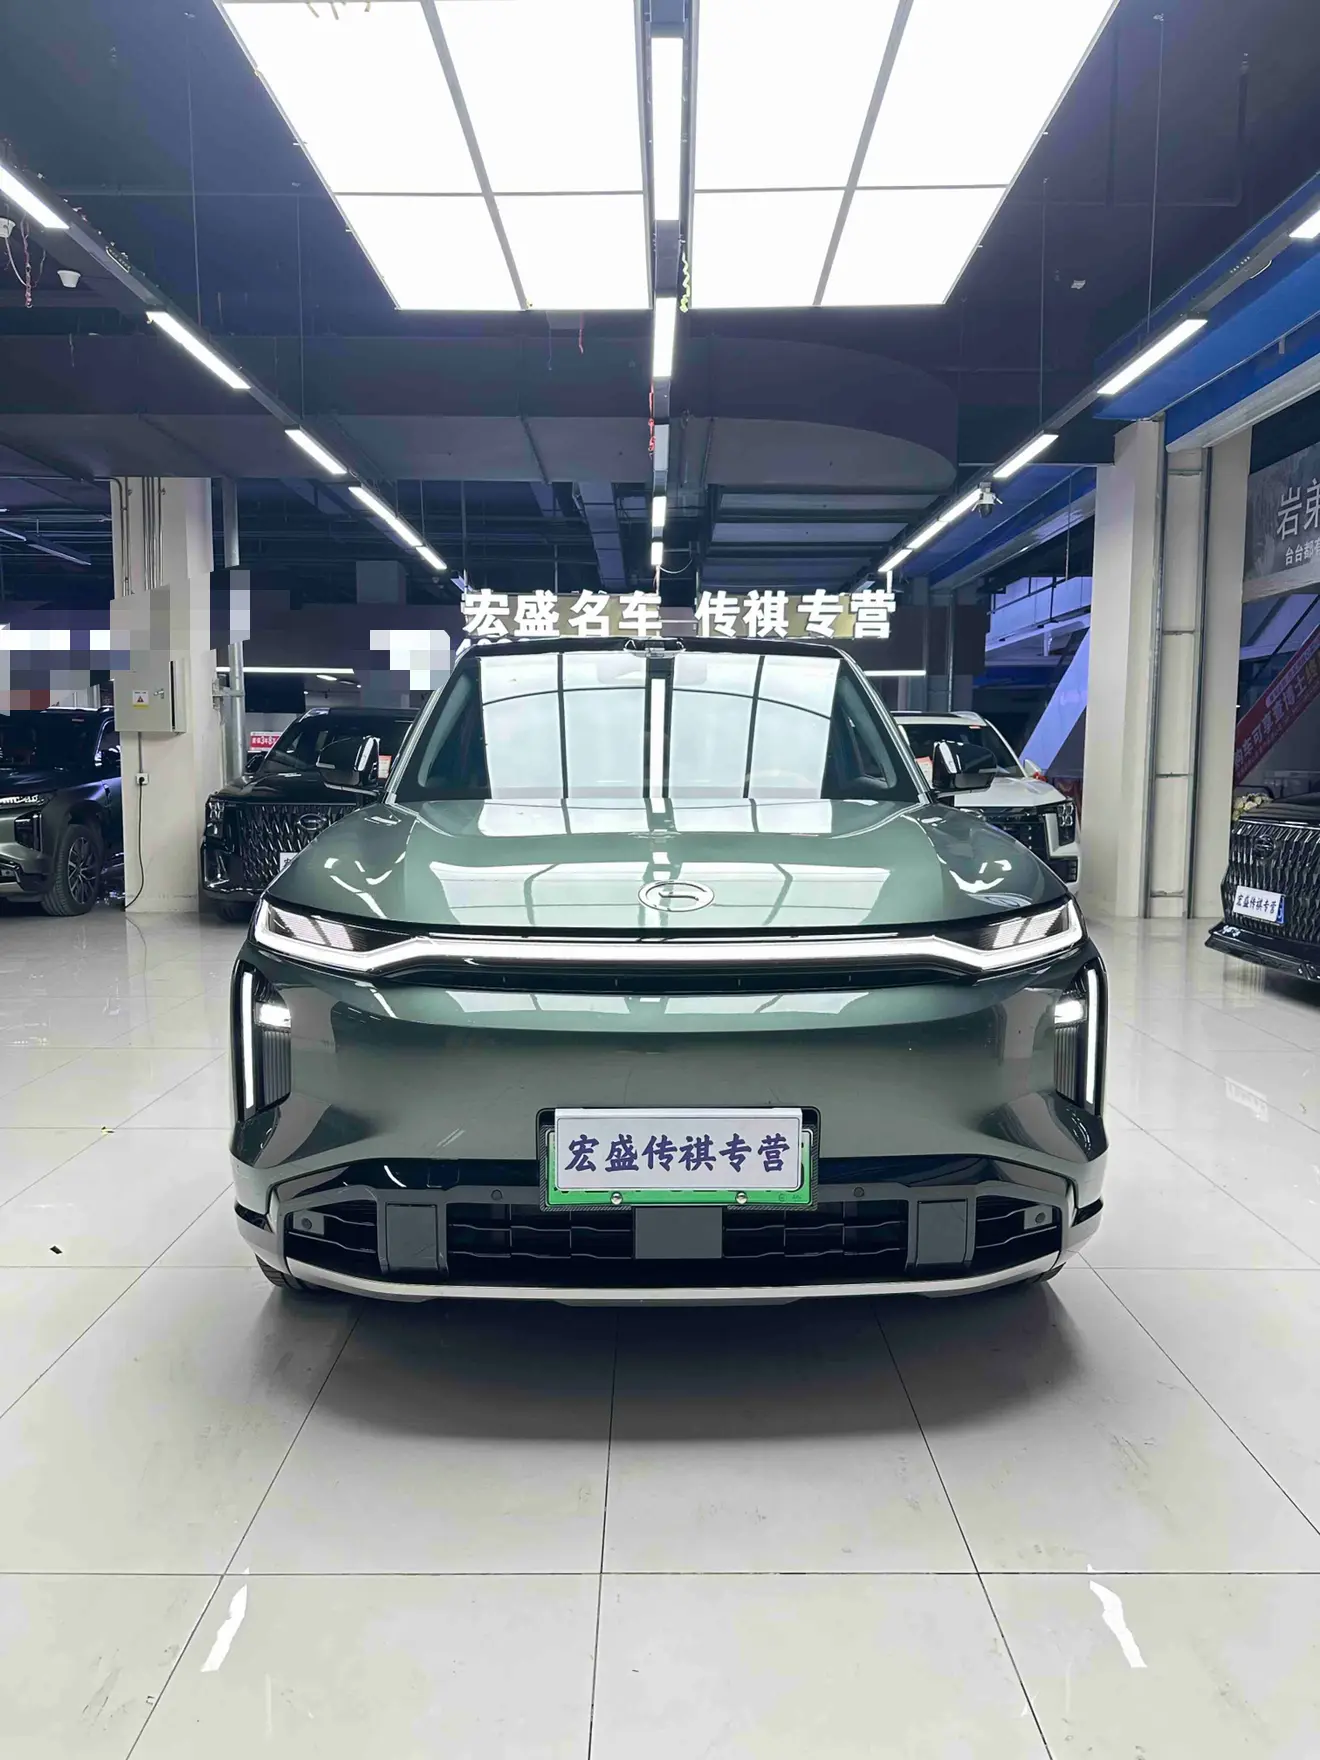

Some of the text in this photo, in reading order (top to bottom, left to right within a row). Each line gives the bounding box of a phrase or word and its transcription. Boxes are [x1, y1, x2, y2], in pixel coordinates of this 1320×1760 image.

[462, 589, 896, 639] 宏盛名车 传祺专营
[564, 1133, 790, 1173] 宏盛传祺专营
